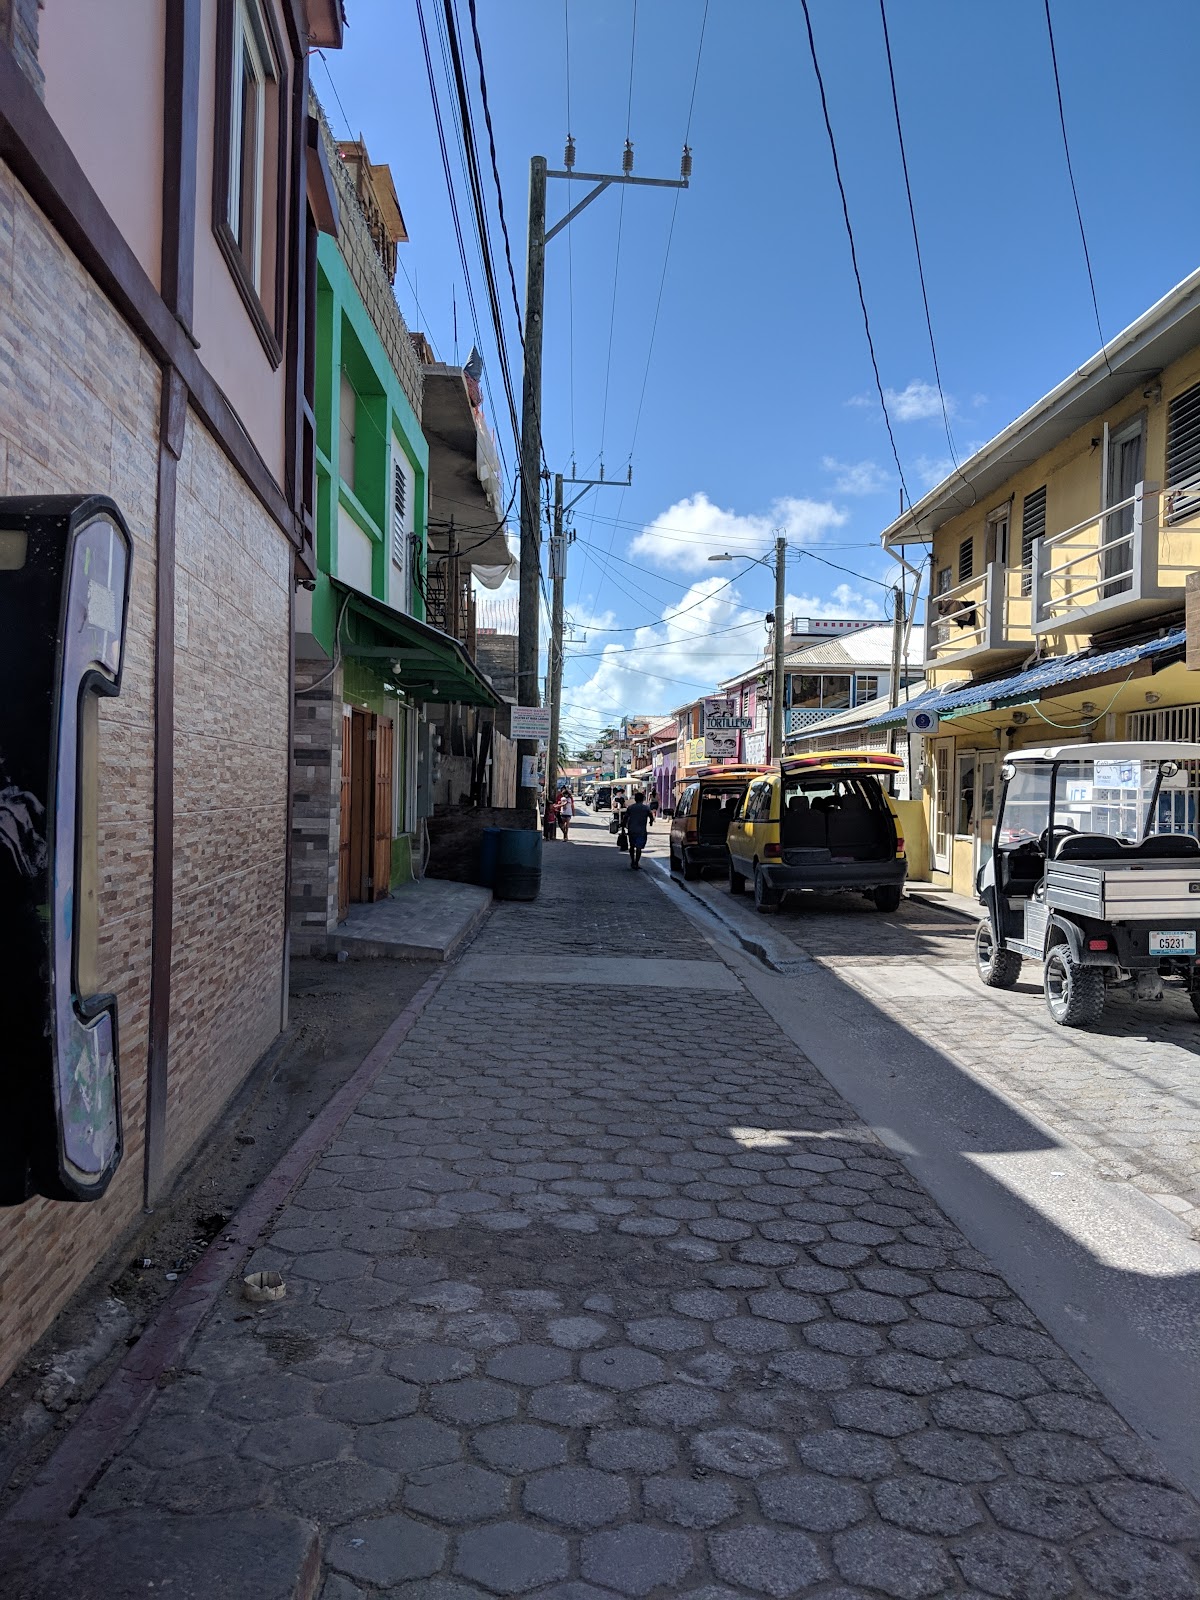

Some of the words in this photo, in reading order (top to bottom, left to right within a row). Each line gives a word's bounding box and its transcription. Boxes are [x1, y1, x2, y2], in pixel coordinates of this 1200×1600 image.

[707, 718, 752, 728] TORTILLERIA
[1070, 788, 1087, 801] ICE
[1160, 938, 1184, 949] C5231
